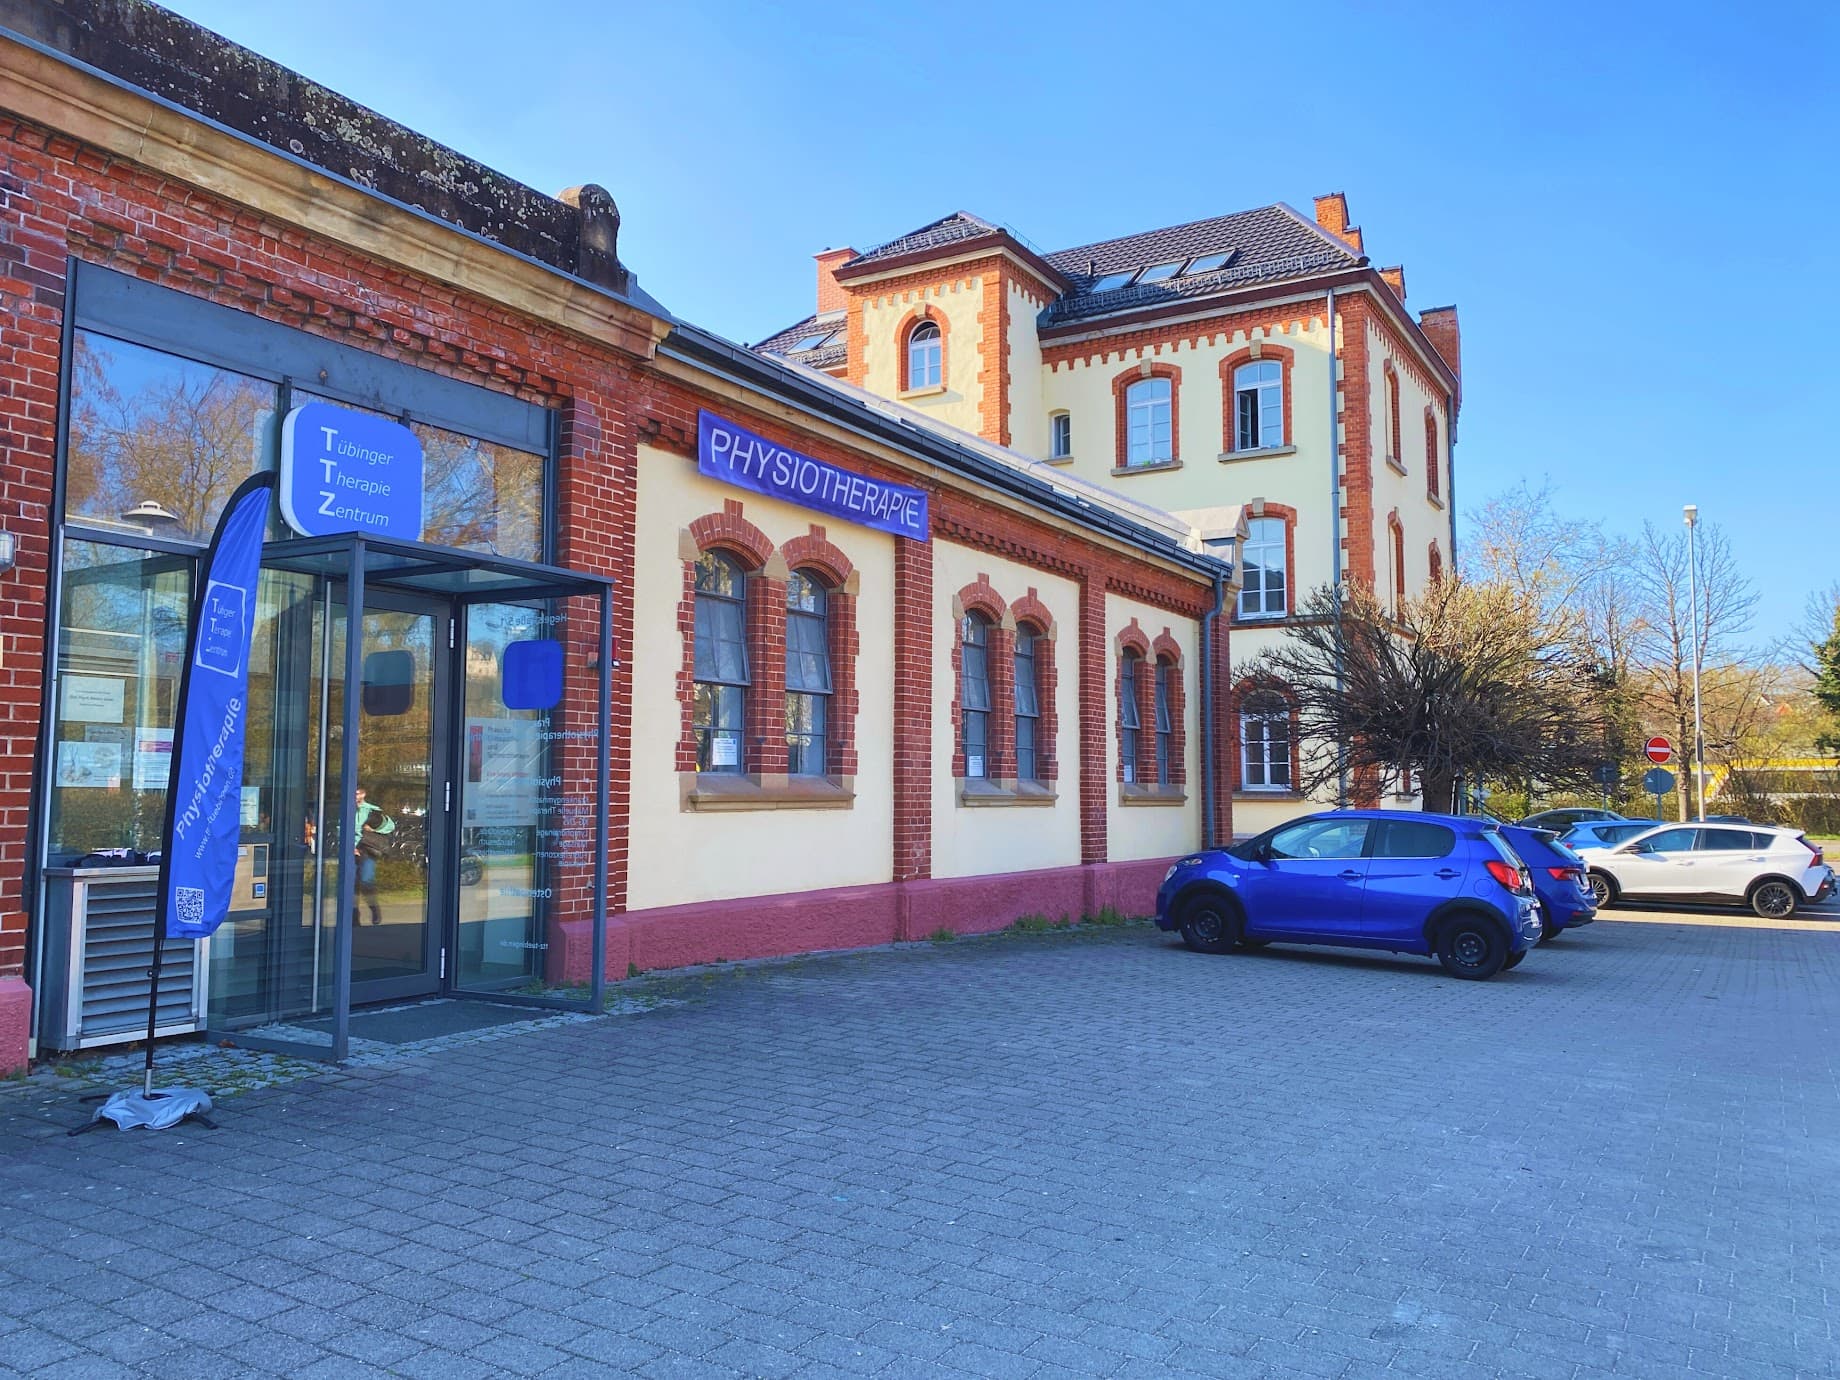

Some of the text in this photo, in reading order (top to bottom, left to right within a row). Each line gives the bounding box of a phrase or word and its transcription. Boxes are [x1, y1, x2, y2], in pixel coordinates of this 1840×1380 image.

[320, 426, 394, 466] Tübinger
[319, 458, 391, 497] Therapie
[710, 428, 920, 529] PHYSIOTHERAPIE
[318, 490, 389, 527] Zentrum
[175, 697, 242, 841] Physiotherapie
